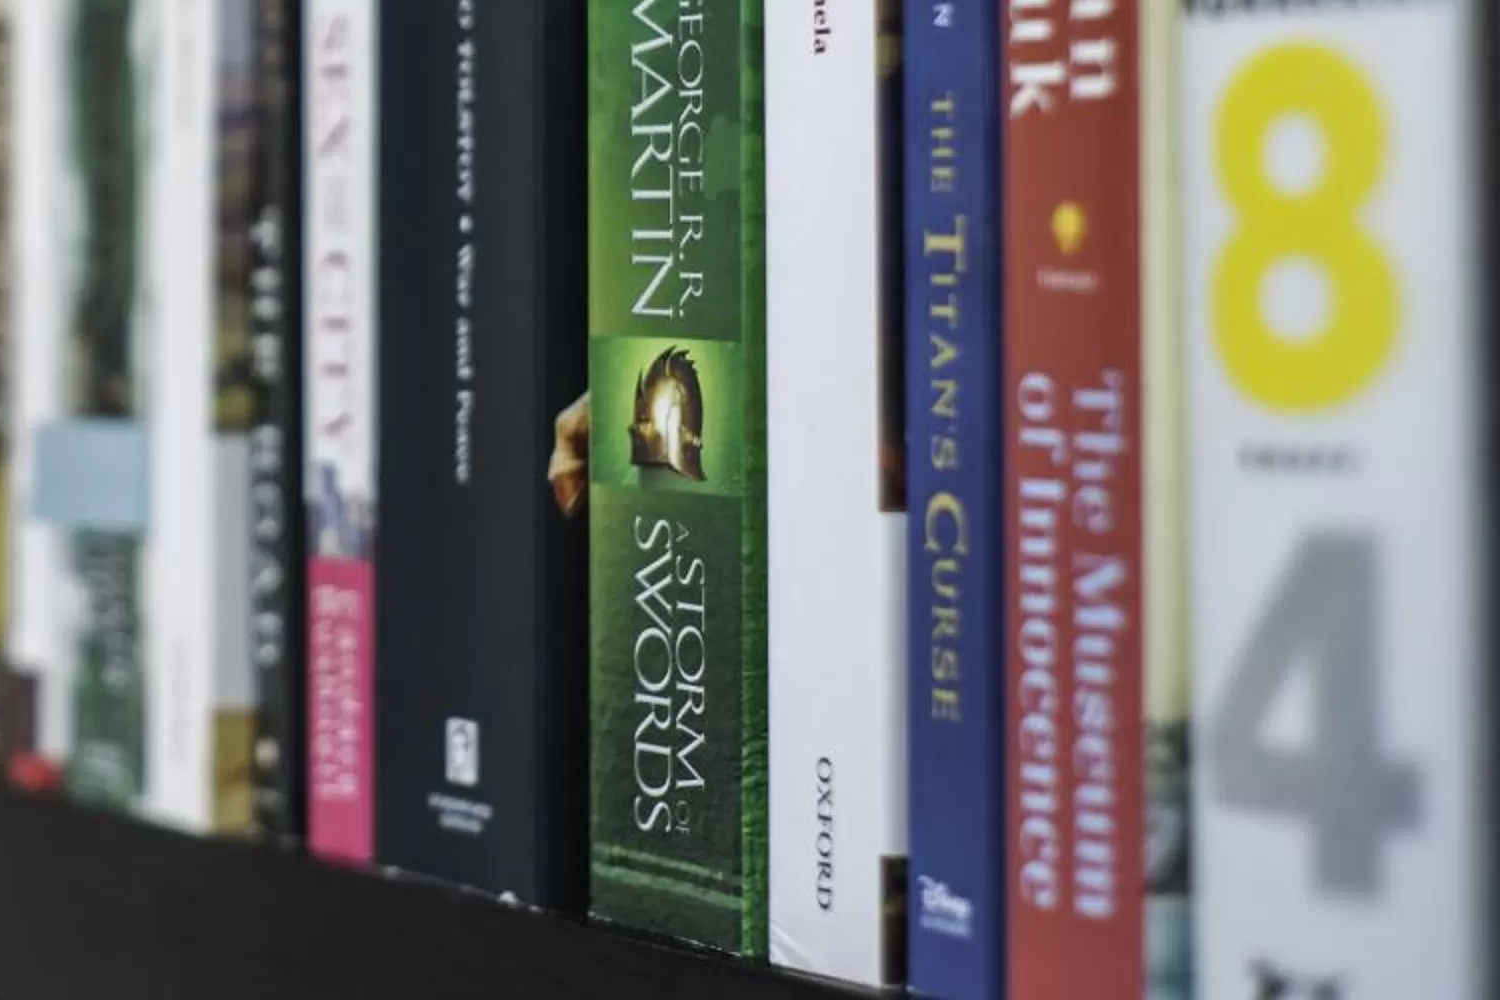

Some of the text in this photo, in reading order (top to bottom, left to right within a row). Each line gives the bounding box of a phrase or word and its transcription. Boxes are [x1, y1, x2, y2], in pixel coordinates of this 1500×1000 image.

[929, 91, 958, 194] THE
[1210, 39, 1400, 416] 8
[632, 515, 672, 834] SWORDS
[674, 521, 705, 837] A STORM OF
[923, 491, 970, 723] CURSE
[1017, 372, 1069, 909] of Innocence
[1070, 368, 1127, 920] The Museum
[1211, 529, 1426, 902] 4
[814, 755, 834, 912] OXFORD
